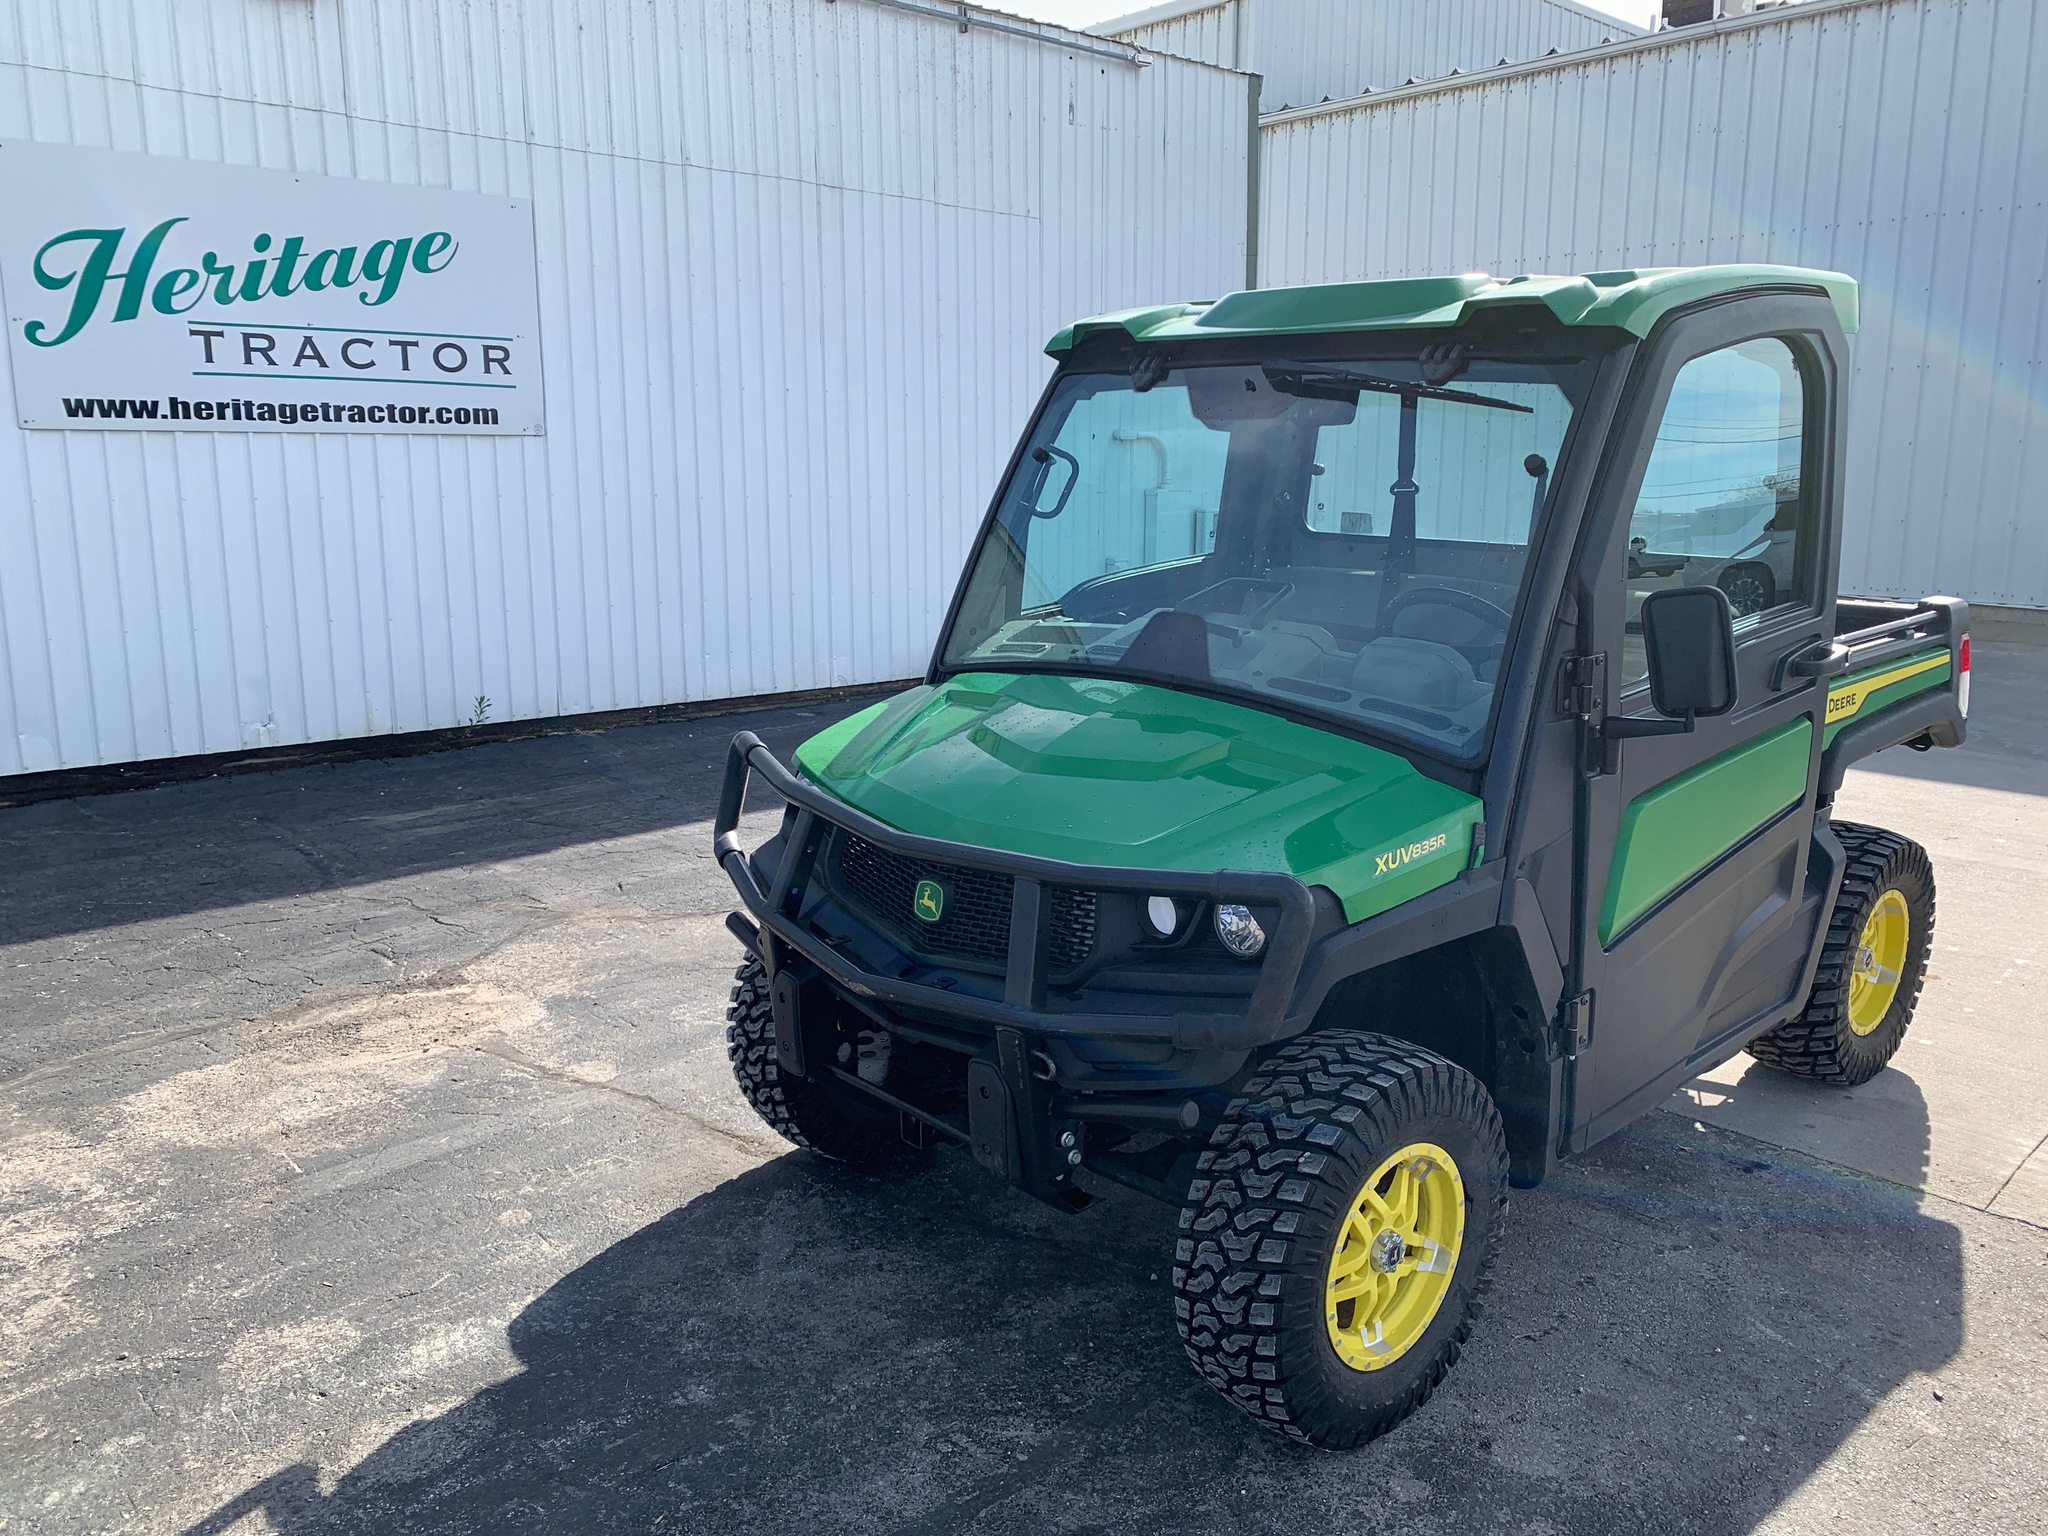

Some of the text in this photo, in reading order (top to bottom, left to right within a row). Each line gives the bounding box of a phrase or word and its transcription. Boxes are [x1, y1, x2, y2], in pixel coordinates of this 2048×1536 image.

[24, 217, 459, 346] Heritage
[188, 328, 512, 375] TRACTOR
[62, 396, 499, 425] www.heritagetractor.com
[1829, 693, 1856, 713] DEERE
[1375, 834, 1445, 875] XUV835R
